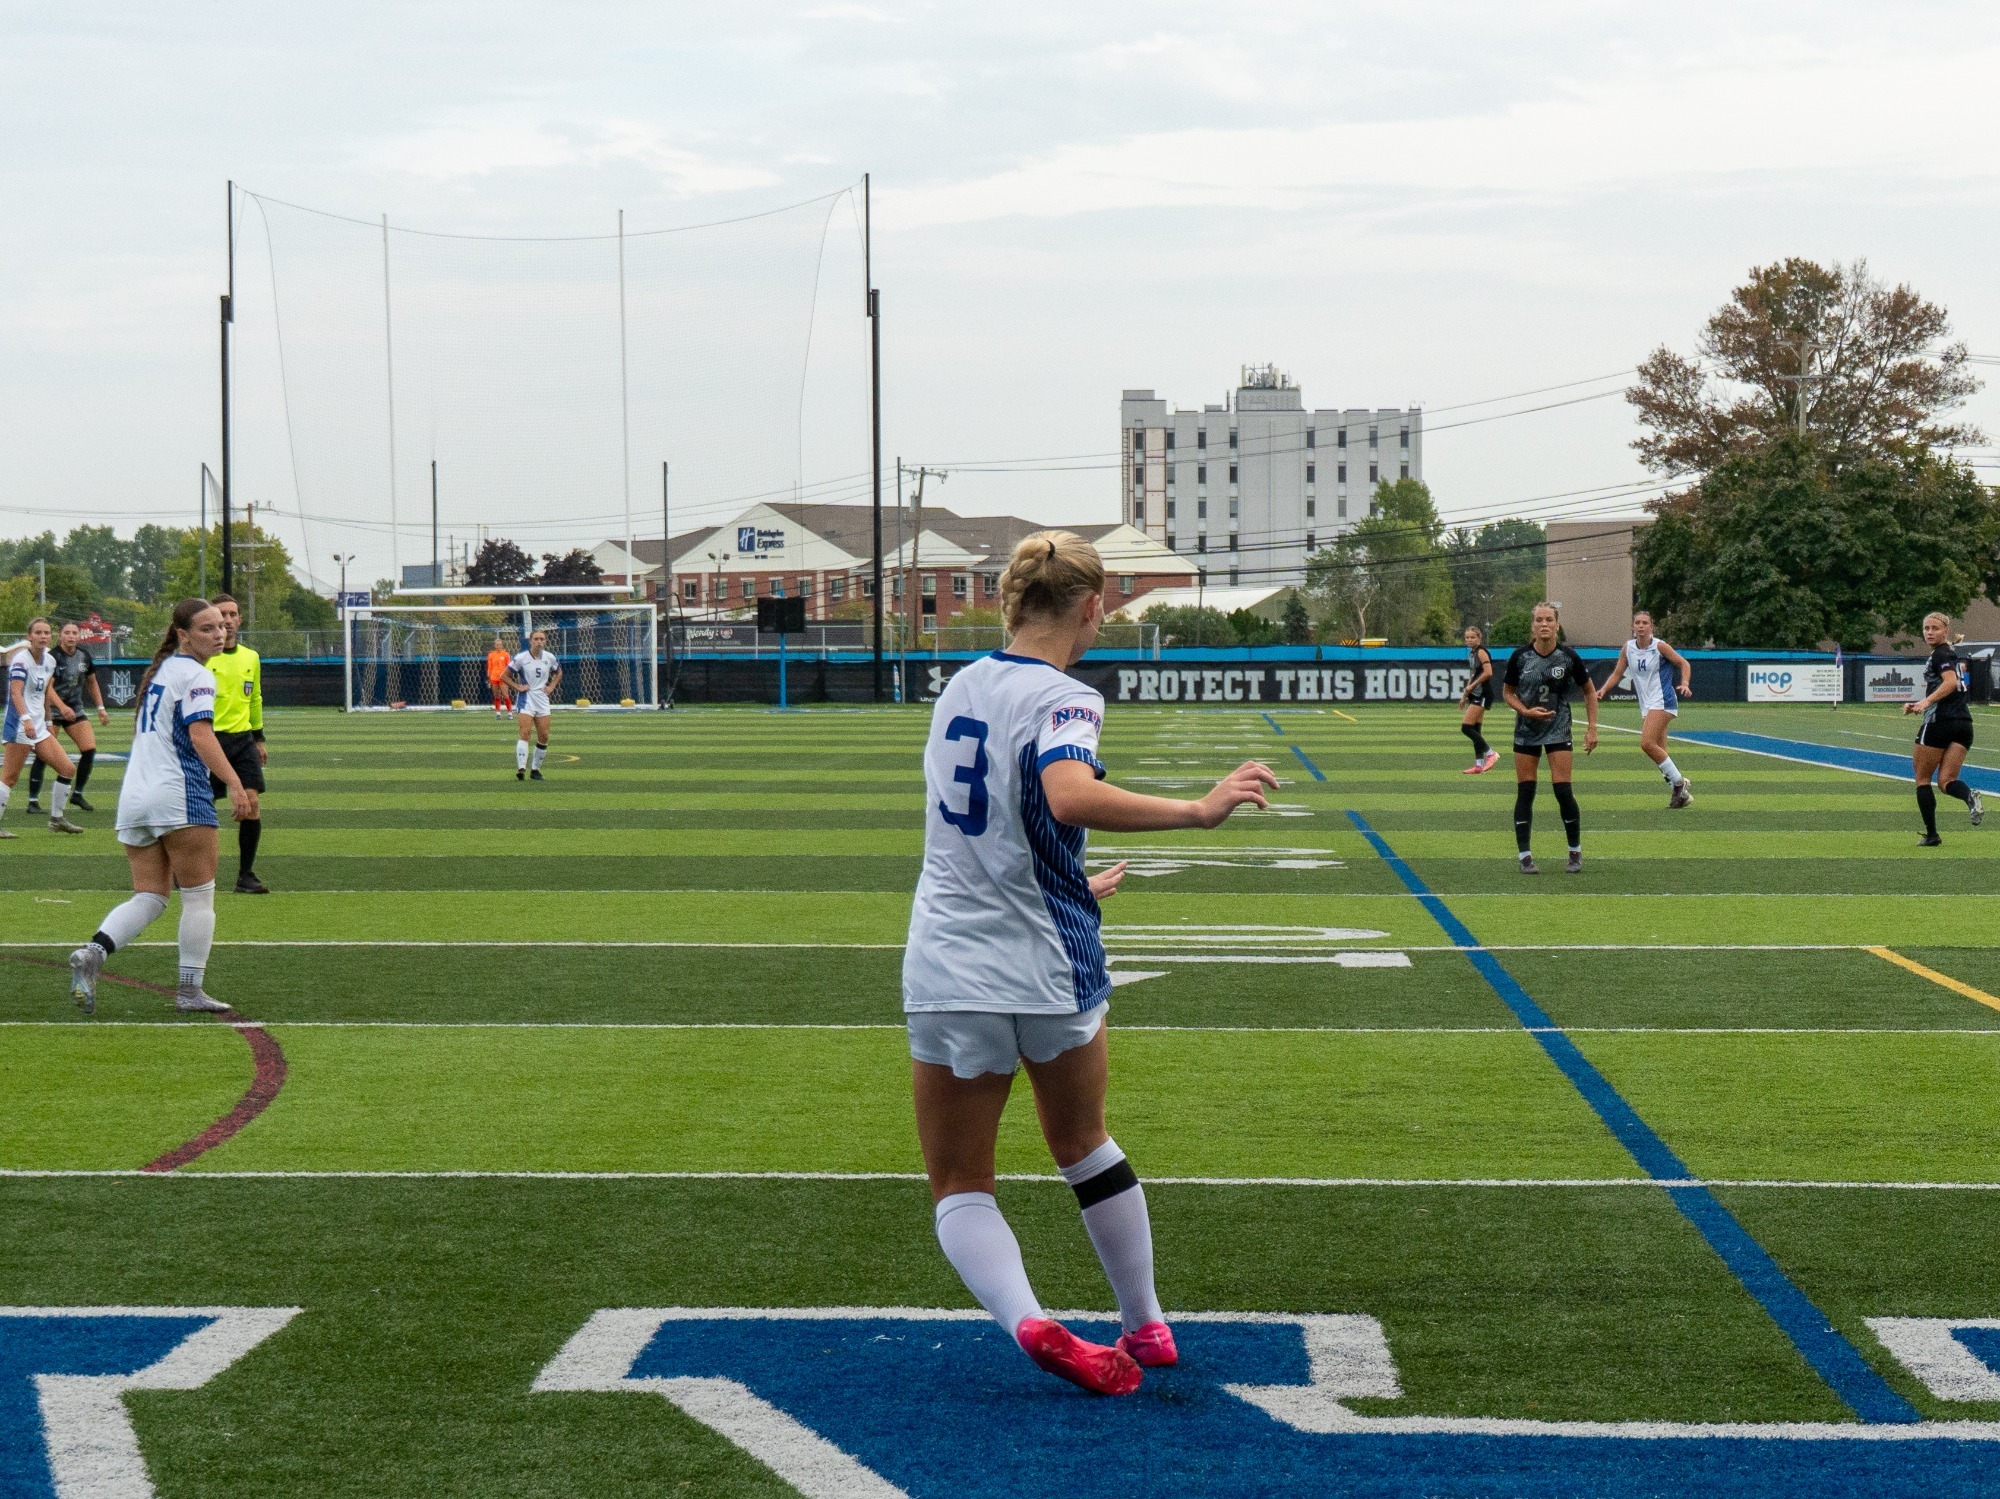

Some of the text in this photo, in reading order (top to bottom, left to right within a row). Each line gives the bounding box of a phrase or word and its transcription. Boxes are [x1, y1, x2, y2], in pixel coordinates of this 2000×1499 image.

[757, 538, 785, 551] Express
[535, 667, 542, 678] 5
[1637, 659, 1647, 672] 14
[1118, 668, 1471, 701] PROTECT THIS HOUSE
[1539, 685, 1550, 703] 2
[142, 682, 167, 733] 17
[939, 716, 989, 837] 3
